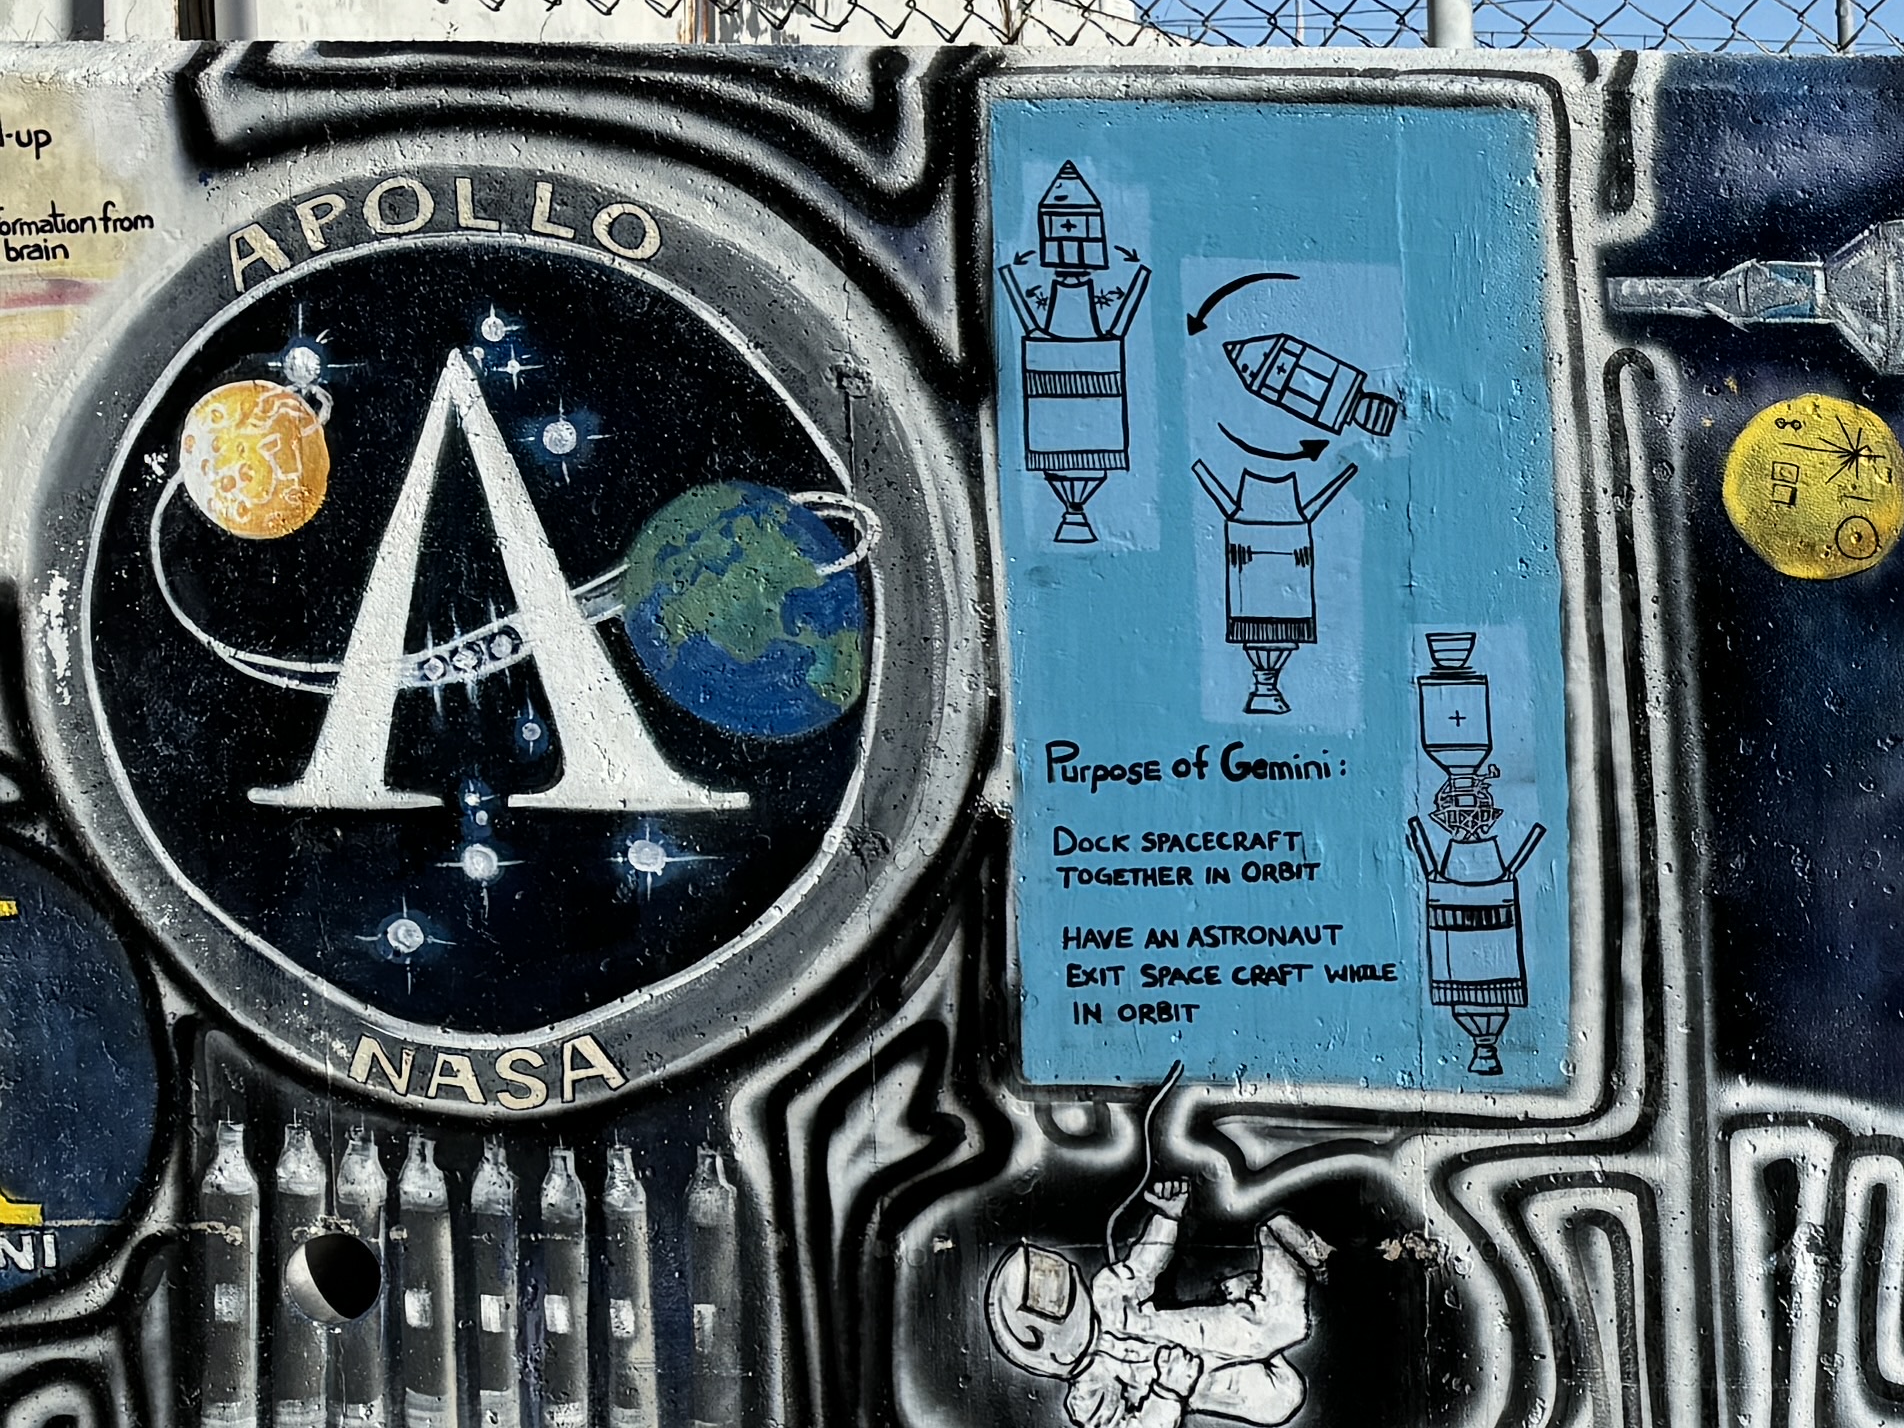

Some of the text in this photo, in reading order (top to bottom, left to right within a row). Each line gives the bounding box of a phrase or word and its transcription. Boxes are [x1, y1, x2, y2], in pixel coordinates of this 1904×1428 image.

[98, 201, 154, 234] from
[227, 176, 662, 291] APOLLO
[4, 239, 69, 262] brain
[247, 346, 752, 811] A
[1172, 745, 1209, 780] of
[1141, 831, 1302, 853] SPACECRAFT
[1056, 861, 1321, 888] TOGETHER IN ORBIT
[1062, 924, 1343, 950] HAVE AN ASTRONAUT
[1066, 963, 1399, 988] EXIT SPACE CRAFT WHILE
[1073, 1001, 1200, 1024] IN ORBIT
[347, 1034, 627, 1111] NASA
